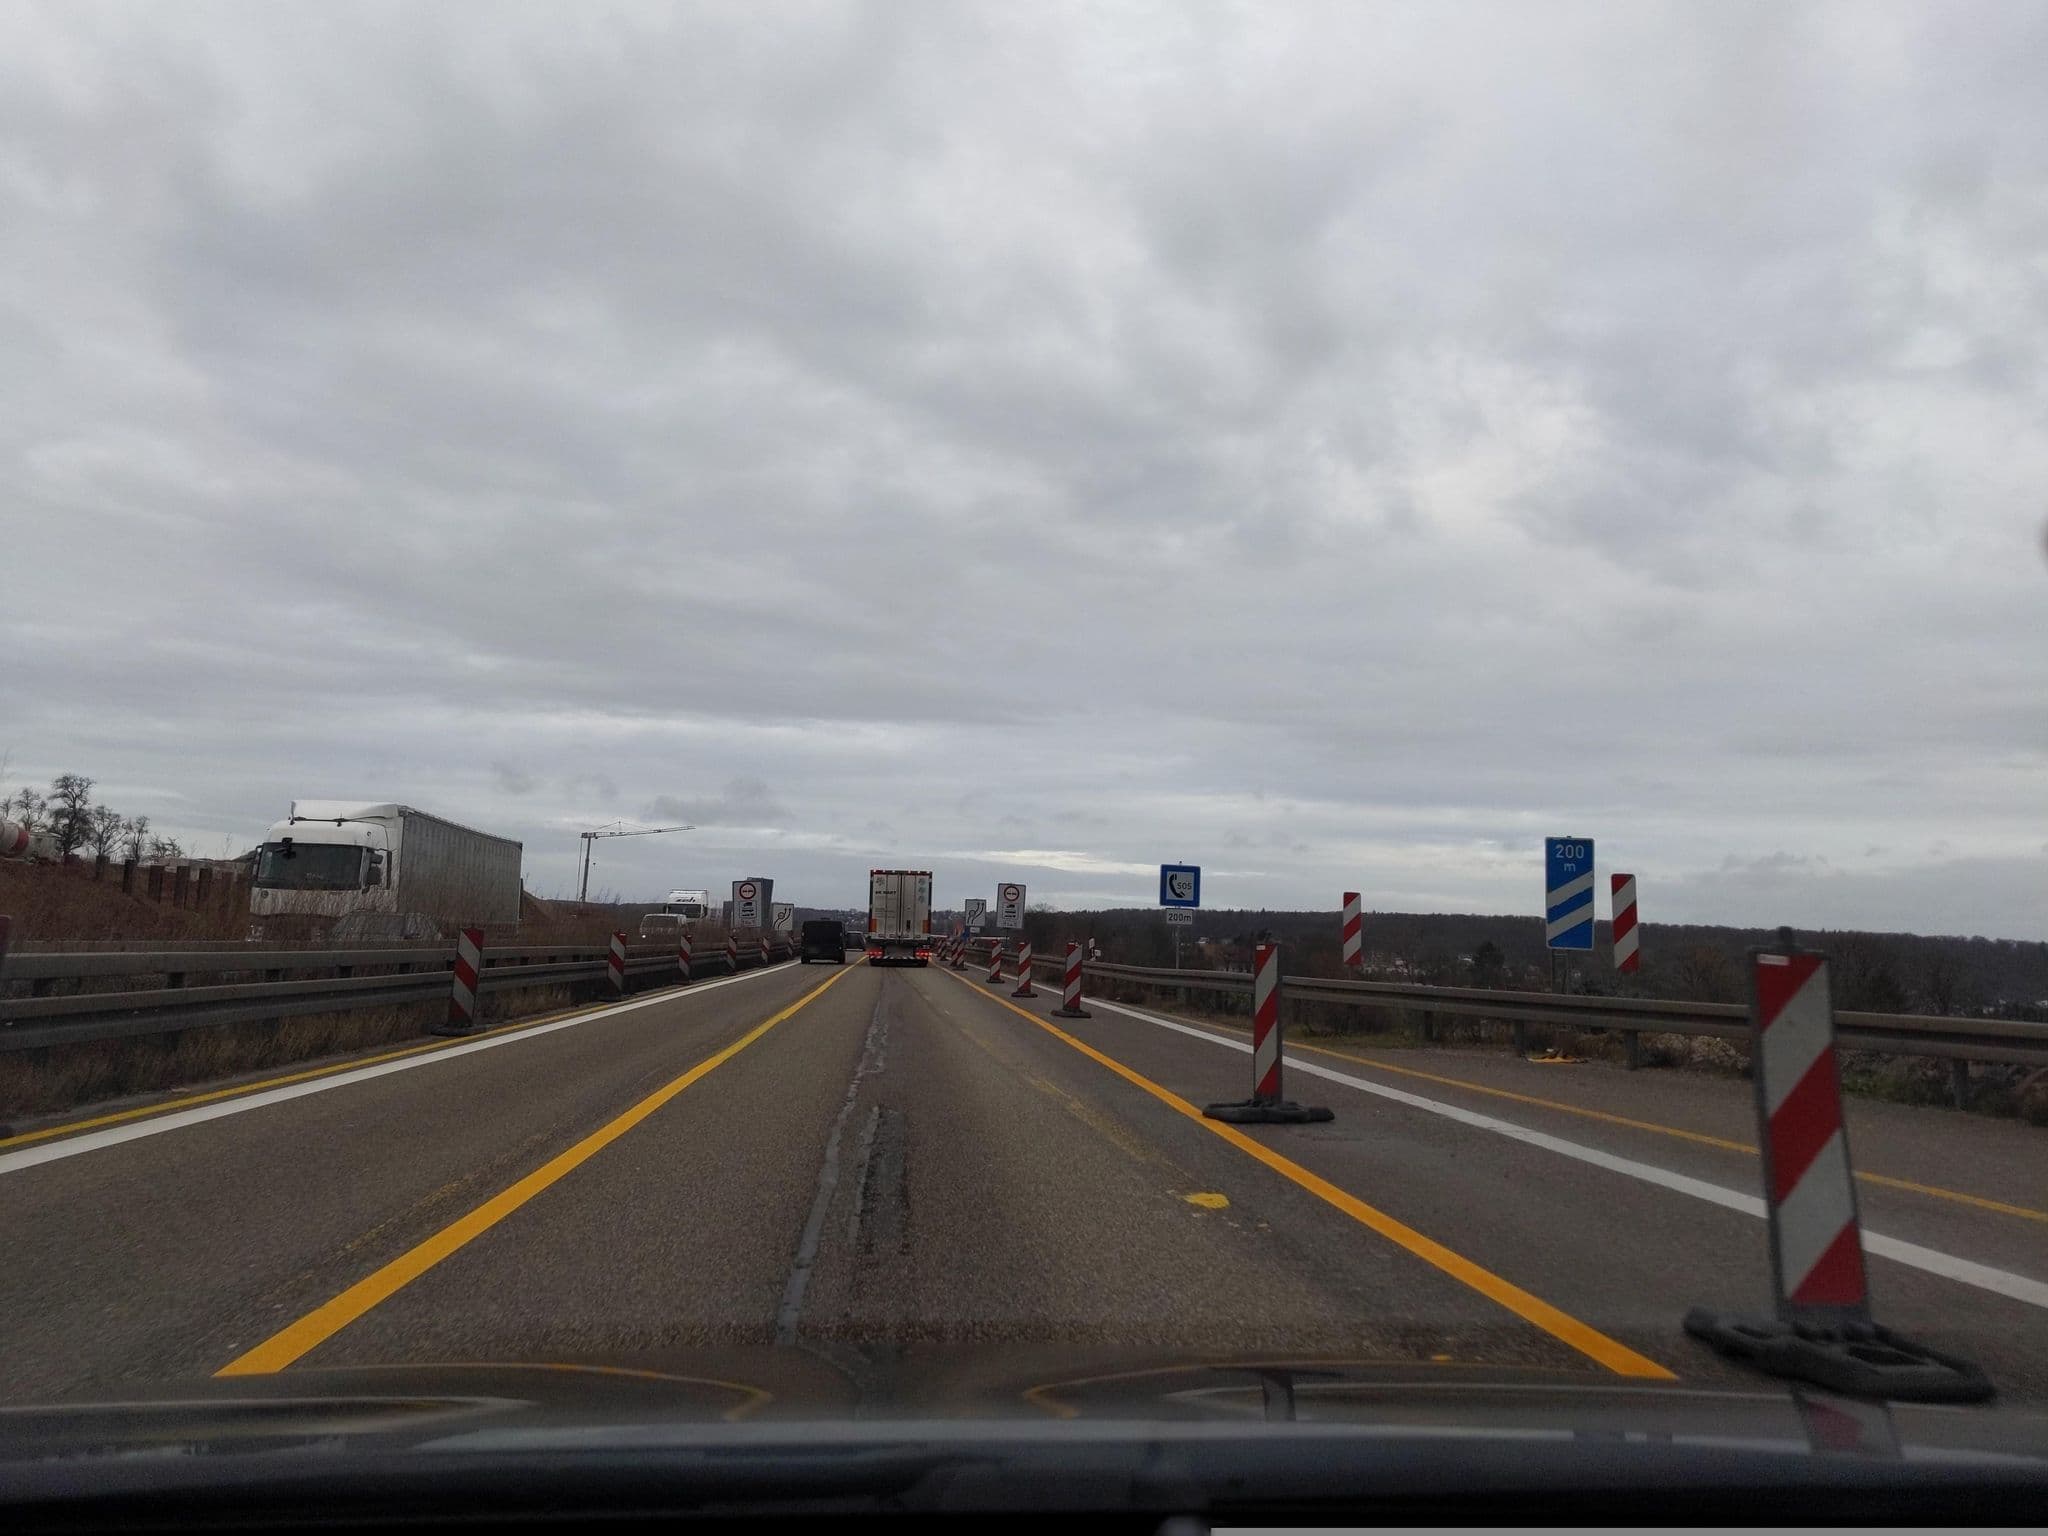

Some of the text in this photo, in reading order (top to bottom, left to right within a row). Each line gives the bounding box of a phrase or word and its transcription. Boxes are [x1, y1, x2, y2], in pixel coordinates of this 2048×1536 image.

[1555, 844, 1585, 859] 200
[1563, 862, 1577, 872] m
[1176, 881, 1192, 890] SOS
[1168, 913, 1192, 922] 200m
